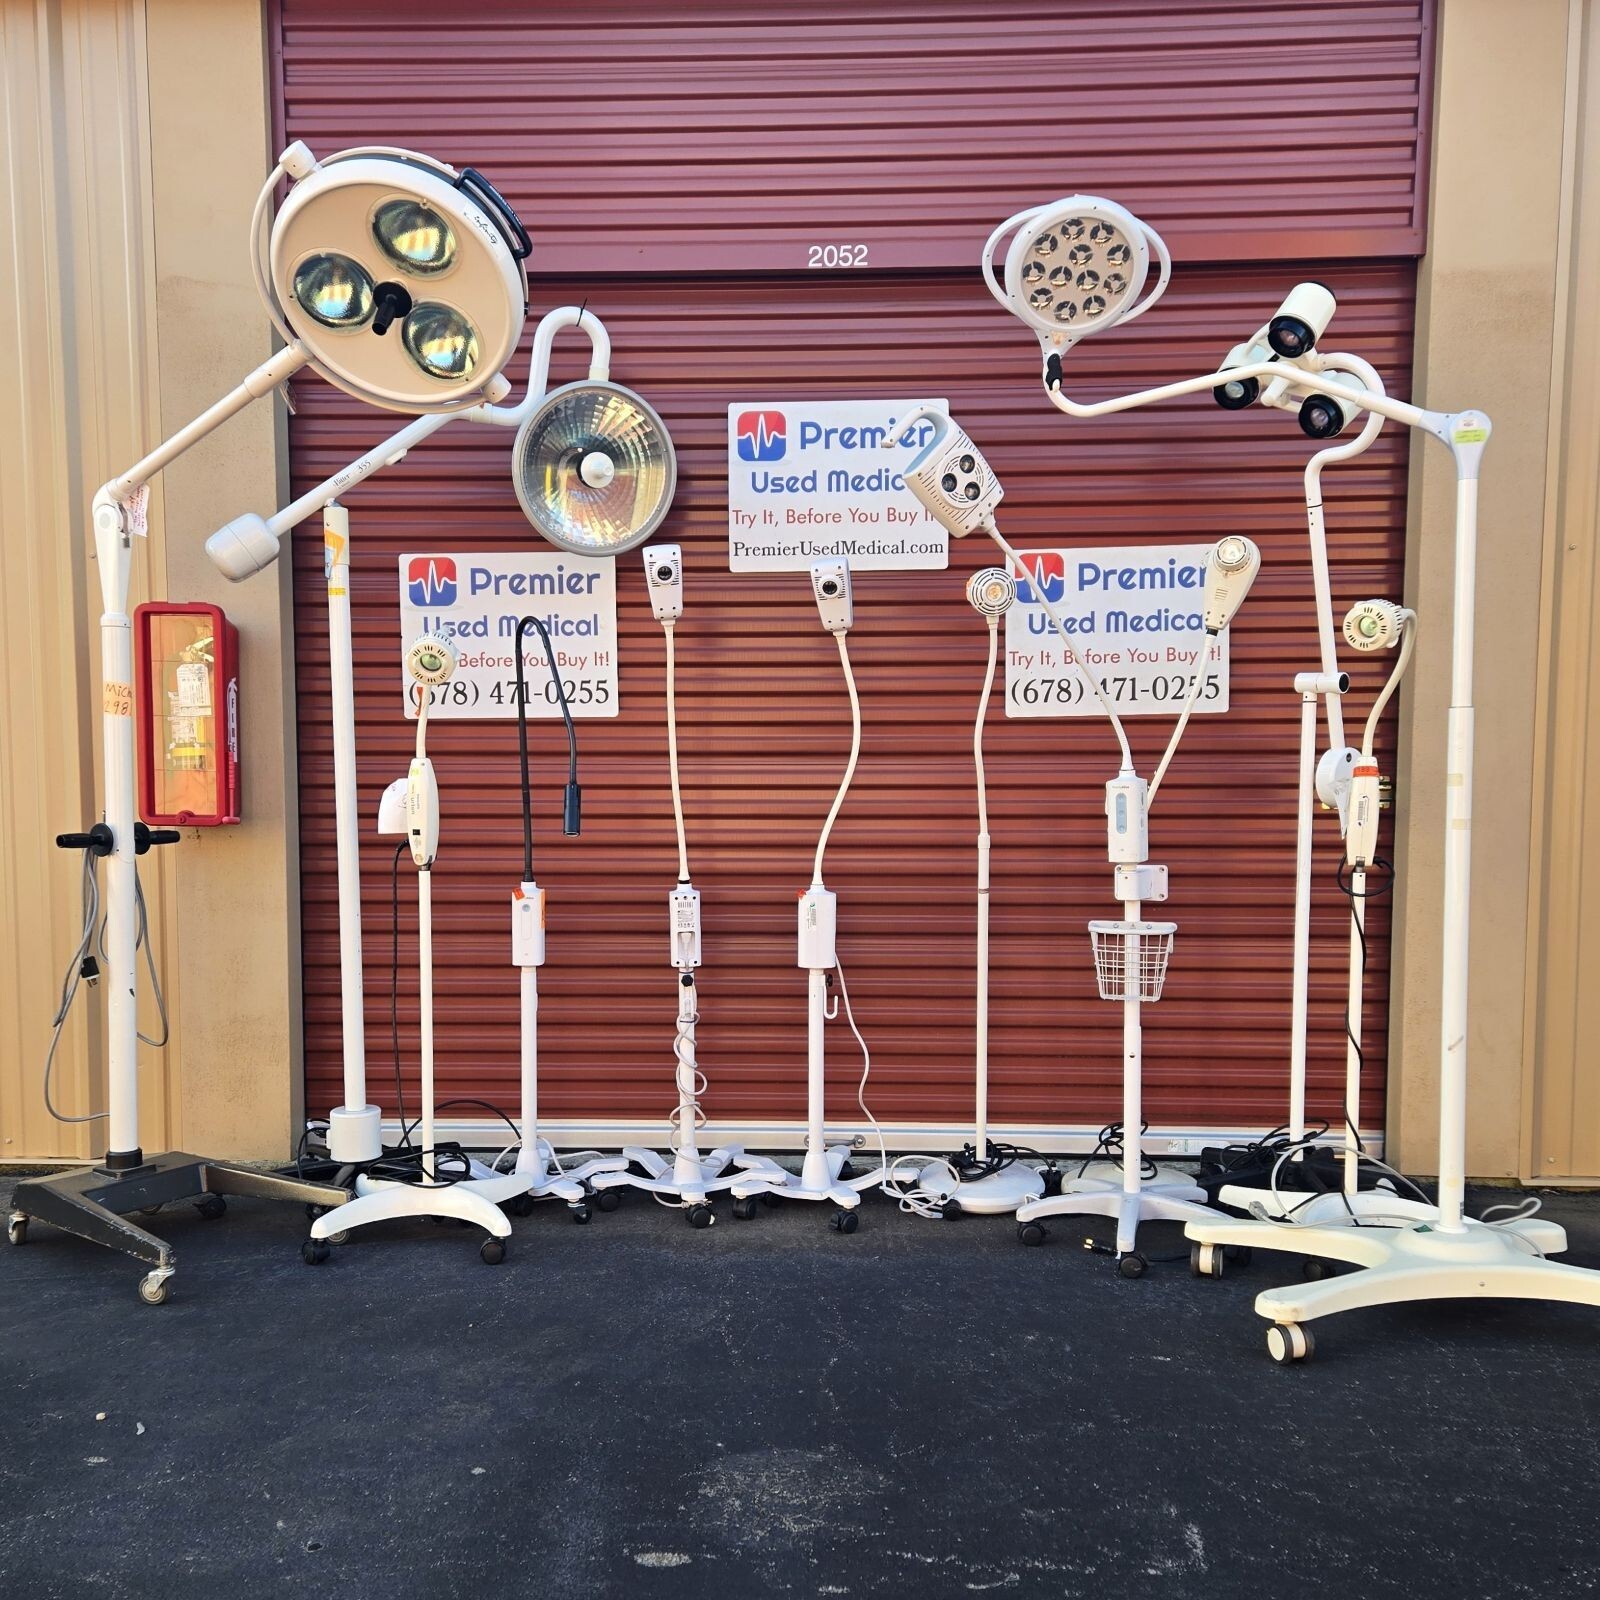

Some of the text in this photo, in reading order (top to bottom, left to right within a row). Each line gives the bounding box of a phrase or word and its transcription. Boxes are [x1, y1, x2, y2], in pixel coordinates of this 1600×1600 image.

[808, 244, 868, 267] 2052
[751, 468, 906, 493] Used Medic
[732, 510, 757, 529] Try
[763, 510, 778, 527] It,
[786, 508, 842, 525] Before
[848, 507, 880, 523] You
[887, 507, 918, 527] Buy
[733, 539, 944, 558] PremierUsedMedical.com
[470, 565, 600, 596] Premier
[1078, 558, 1207, 592] Premier
[424, 613, 599, 638] Used Medical
[1028, 608, 1204, 635] Used Medica
[459, 651, 609, 671] Before You Buy It!
[1009, 650, 1034, 670] Try
[1040, 650, 1056, 668] It,
[1064, 648, 1121, 665] Bfore
[1127, 647, 1159, 663] You
[1166, 647, 1198, 666] Buy
[490, 679, 609, 705] 471-0255
[1011, 676, 1084, 706] (678)
